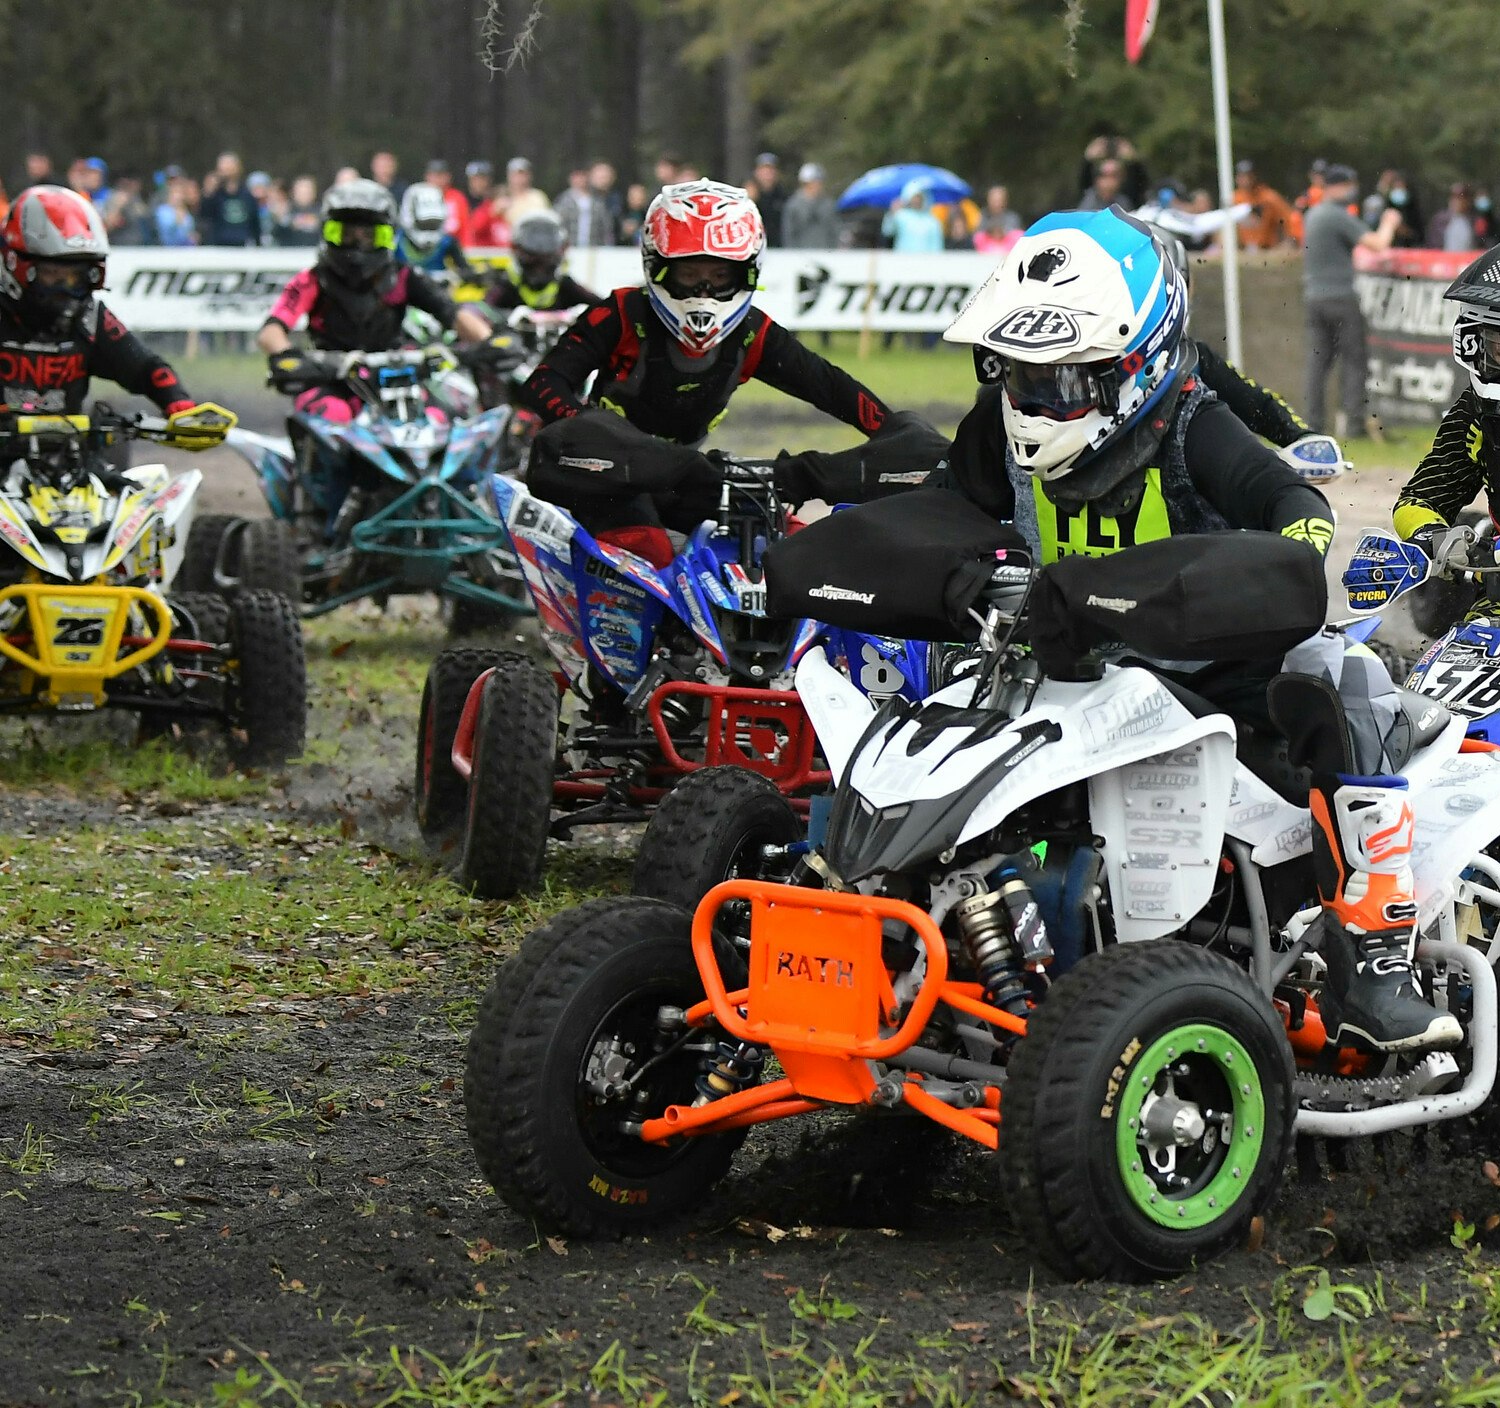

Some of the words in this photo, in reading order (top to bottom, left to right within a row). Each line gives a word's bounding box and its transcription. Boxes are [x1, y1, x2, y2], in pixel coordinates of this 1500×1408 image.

[1356, 590, 1388, 602] CYCRA
[53, 618, 105, 646] 26
[777, 952, 854, 987] RATH
